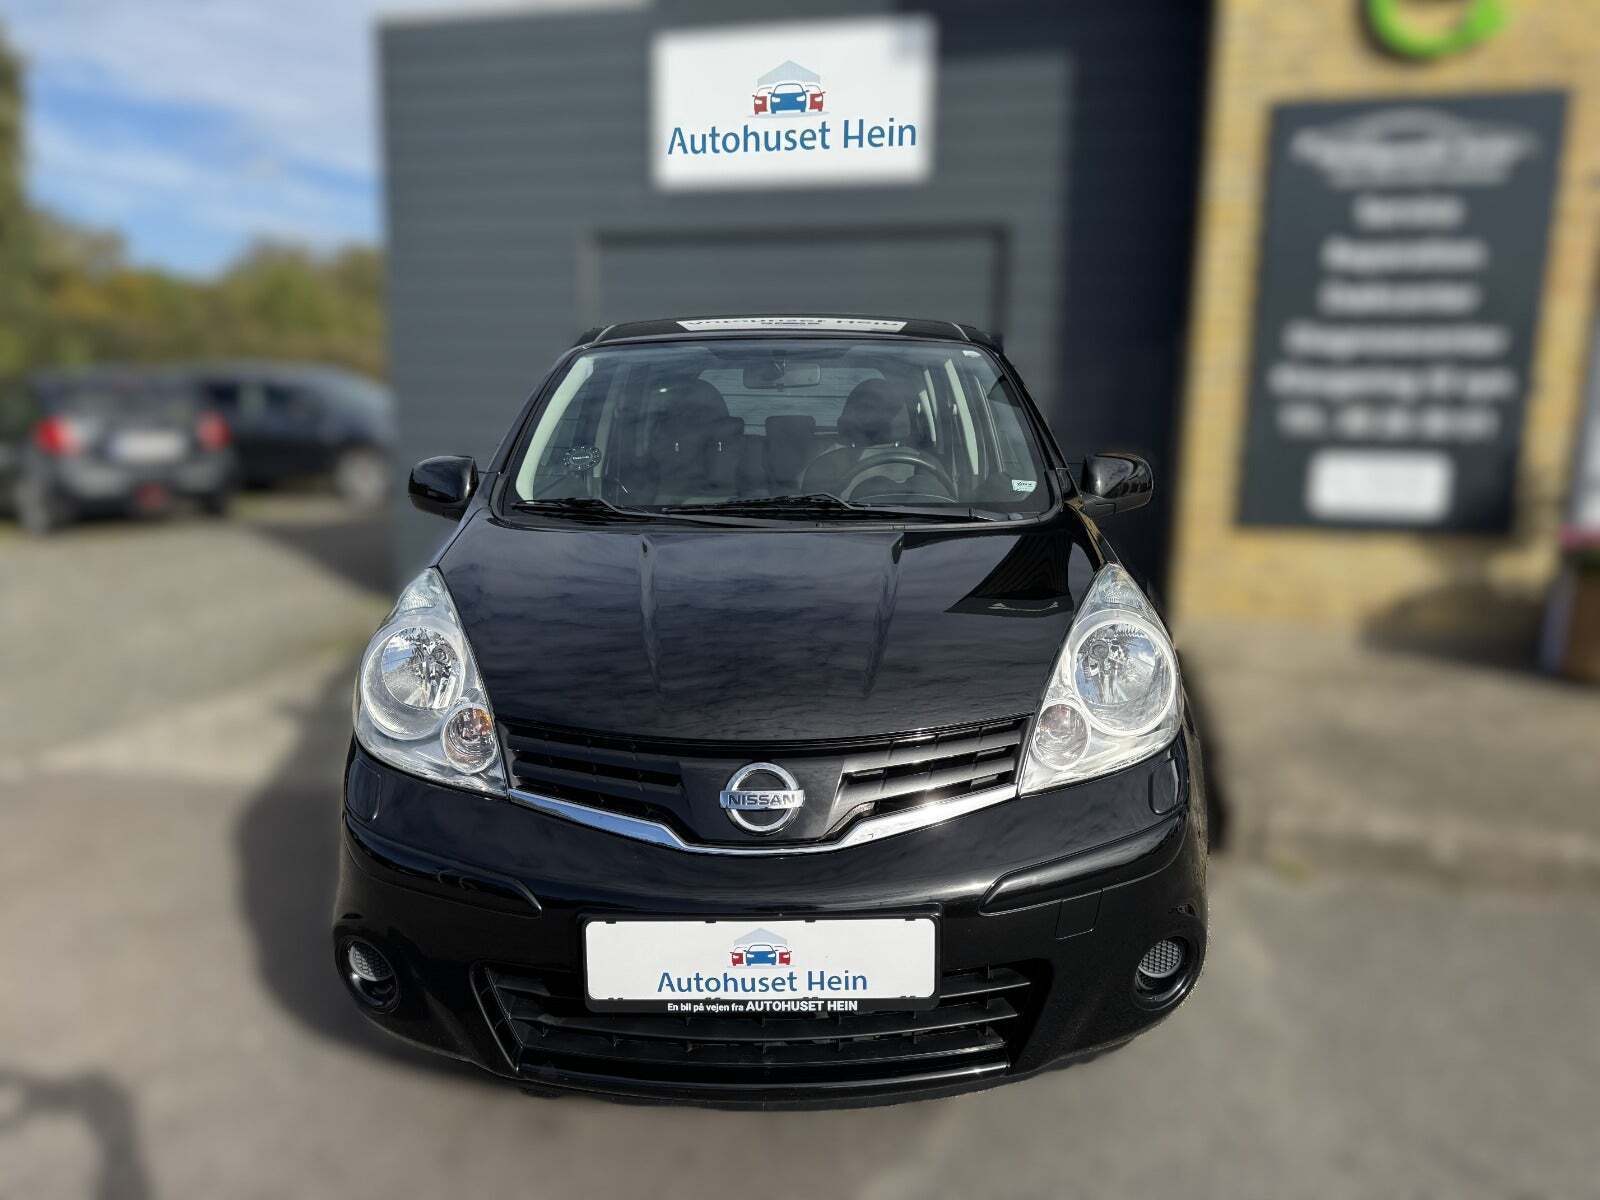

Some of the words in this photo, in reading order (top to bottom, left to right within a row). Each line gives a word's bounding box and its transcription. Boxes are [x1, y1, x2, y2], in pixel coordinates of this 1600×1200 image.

[668, 120, 830, 155] Autohuset
[843, 117, 917, 149] Hein
[727, 794, 795, 807] NISSAN
[657, 970, 797, 993] Autohuset
[807, 970, 867, 992] Hein
[667, 1002, 679, 1012] En
[680, 1002, 692, 1012] bil
[693, 1002, 704, 1013] på
[706, 1003, 730, 1013] vejen
[731, 1002, 745, 1012] fra
[746, 1000, 825, 1012] AUTOHUSET
[827, 1000, 858, 1011] HEIN
